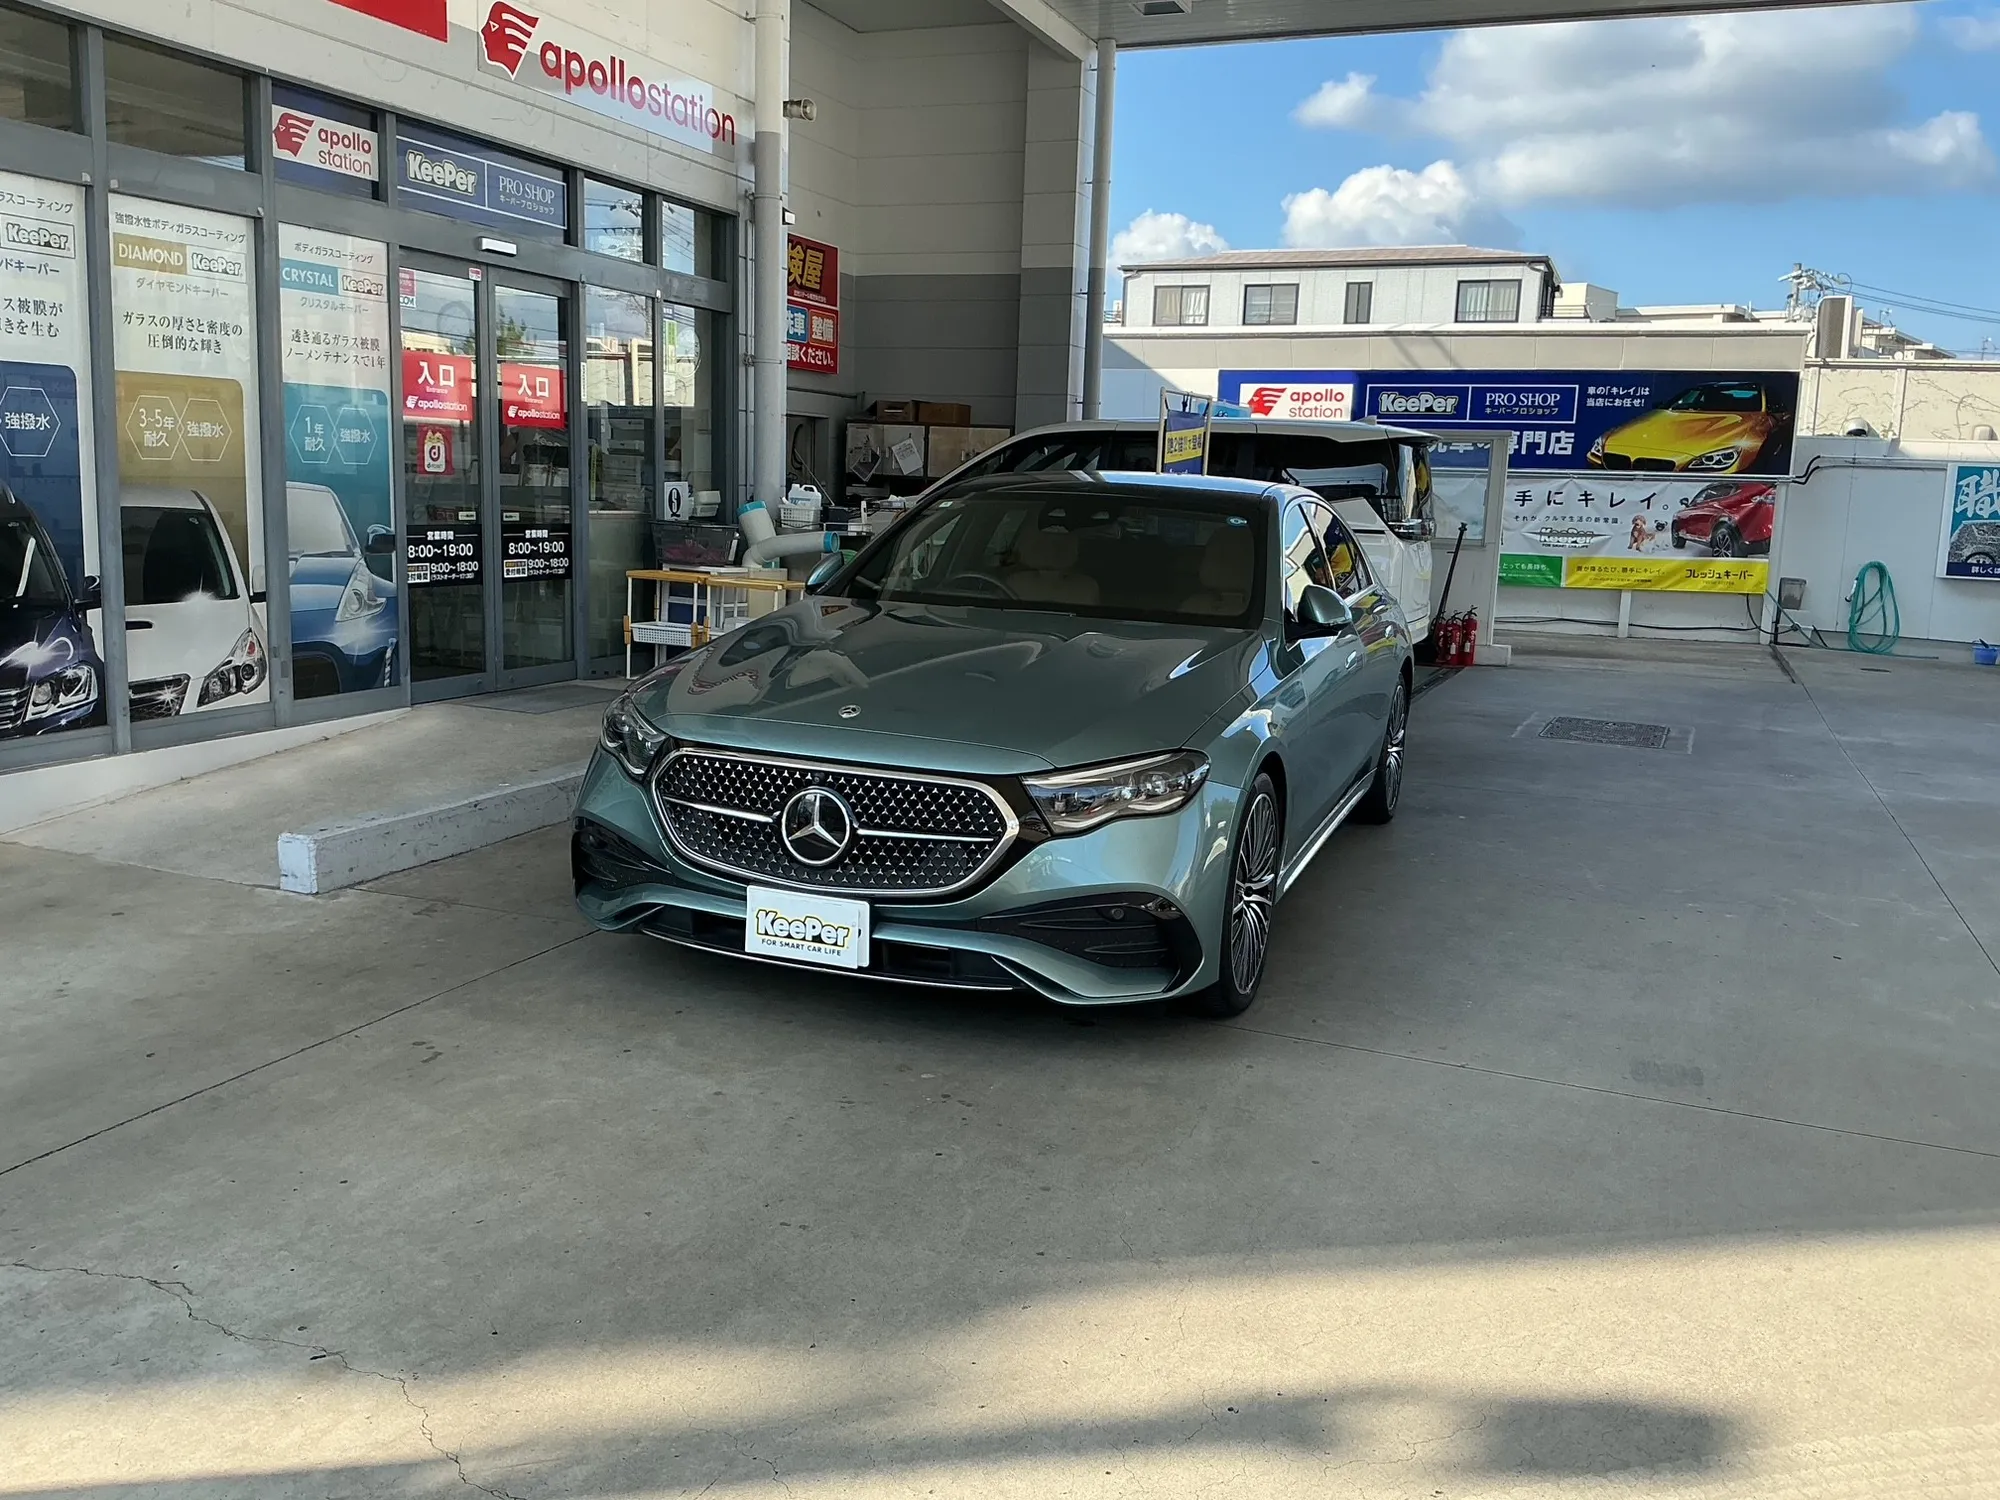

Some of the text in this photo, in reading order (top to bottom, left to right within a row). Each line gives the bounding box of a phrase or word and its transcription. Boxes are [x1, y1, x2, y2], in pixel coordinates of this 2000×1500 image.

[540, 40, 735, 146] apollostation
[317, 127, 372, 155] apollo
[318, 150, 372, 176] station
[406, 149, 478, 196] KeePer
[499, 176, 555, 204] PRO SHOP
[500, 195, 555, 215] キーパープロショップ
[6, 222, 69, 250] KeePer
[114, 211, 246, 244] 強撥水性ボディガラスコーティング
[118, 243, 242, 277] DIAMOND KeePer
[294, 242, 374, 264] ボディガラスコーティング
[136, 276, 229, 297] ダイヤモンドキーパー
[282, 267, 334, 288] CRYSTAL
[341, 274, 384, 296] KeePer
[3, 296, 63, 317] ス被膜が
[300, 296, 370, 315] クリスタルキーパー
[0, 317, 60, 338] きを生む
[122, 311, 243, 337] ガラスの厚さと密度の
[811, 315, 834, 342] 整備
[147, 333, 223, 355] 圧倒的な輝き
[290, 328, 381, 352] 透き通るガラス被膜
[418, 361, 455, 388] 入口
[517, 373, 550, 398] 入口
[1587, 386, 1650, 396] 車の「キレイ」は
[418, 399, 468, 412] apollostation
[1290, 388, 1345, 405] apollo
[1378, 391, 1458, 415] KeePer
[1485, 392, 1561, 407] PRO SHOP
[4, 411, 51, 430] 強撥水
[518, 408, 560, 420] apollostation
[1288, 405, 1343, 419] station
[1484, 407, 1559, 416] キーパープロショップ
[186, 421, 225, 439] 強撥水
[304, 416, 324, 437] 1年
[340, 428, 372, 444] 強撥水
[143, 431, 170, 448] 耐久
[304, 437, 326, 452] 耐久
[427, 530, 454, 541] 営業時間
[525, 529, 549, 539] 営業時間
[1685, 569, 1754, 580] フレッシュキーパー
[756, 909, 850, 948] KeePer
[761, 938, 842, 957] FOR SMART CAR LIFE
